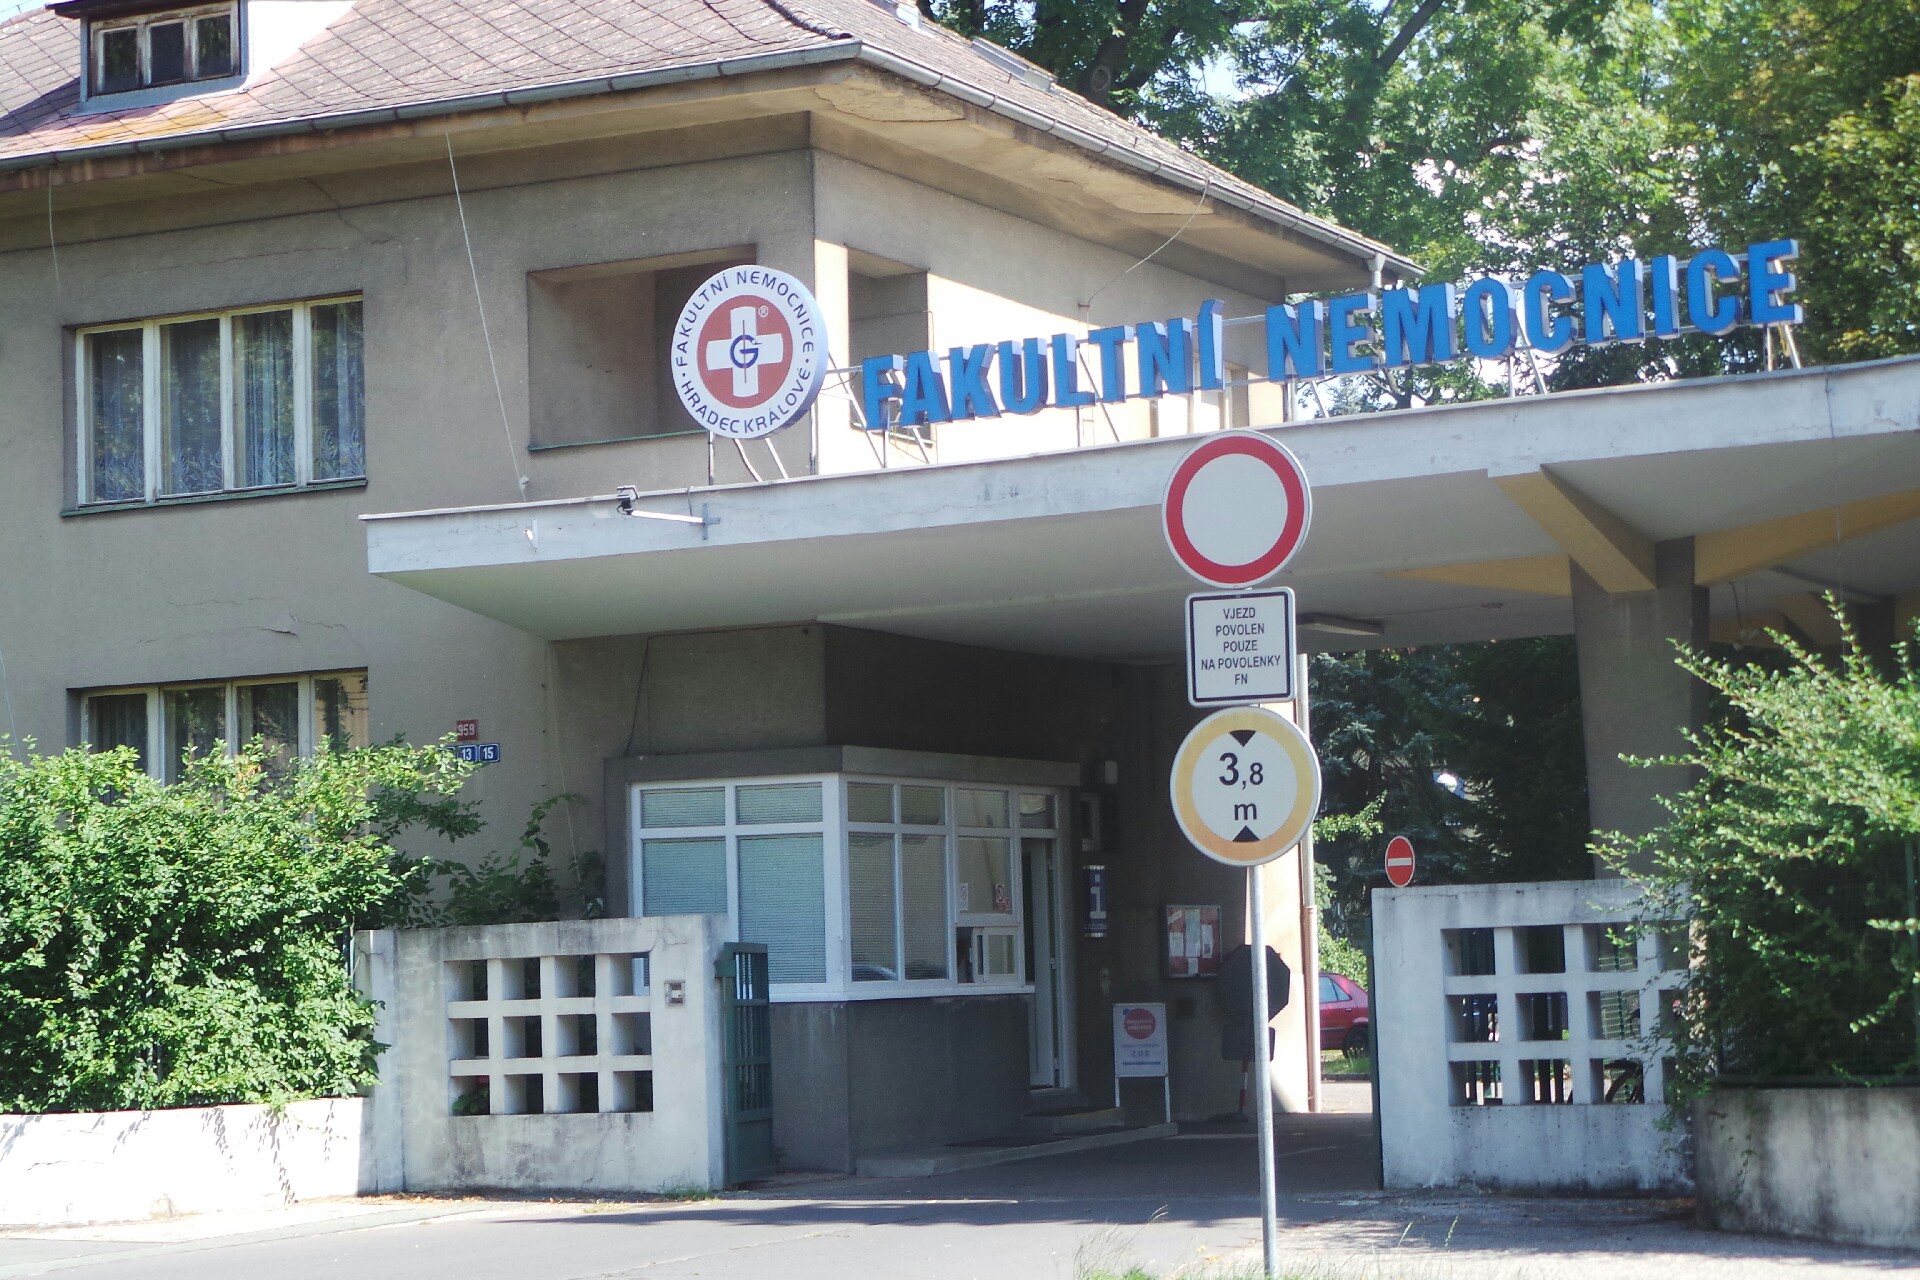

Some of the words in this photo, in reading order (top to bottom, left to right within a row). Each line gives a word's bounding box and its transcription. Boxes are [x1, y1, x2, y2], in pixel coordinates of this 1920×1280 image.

[676, 272, 729, 368] FAKULTNÍ
[736, 270, 814, 353] NEMOCNICE
[862, 299, 1226, 431] FAKULTNÍ
[1266, 239, 1803, 383] NEMOCNICE
[681, 379, 740, 434] HRADEC
[744, 367, 811, 434] KRÁLOVÉ
[1223, 607, 1256, 619] VJEZD
[1216, 622, 1265, 636] POVOLEN
[1223, 639, 1258, 652] POUZE
[1201, 658, 1215, 670] NA
[1217, 655, 1281, 669] POVOLENKY
[1234, 673, 1248, 685] FN
[458, 723, 475, 736] 959
[462, 748, 472, 760] 13
[483, 746, 494, 760] 15
[1219, 752, 1264, 789] 3,8
[1234, 802, 1257, 821] m
